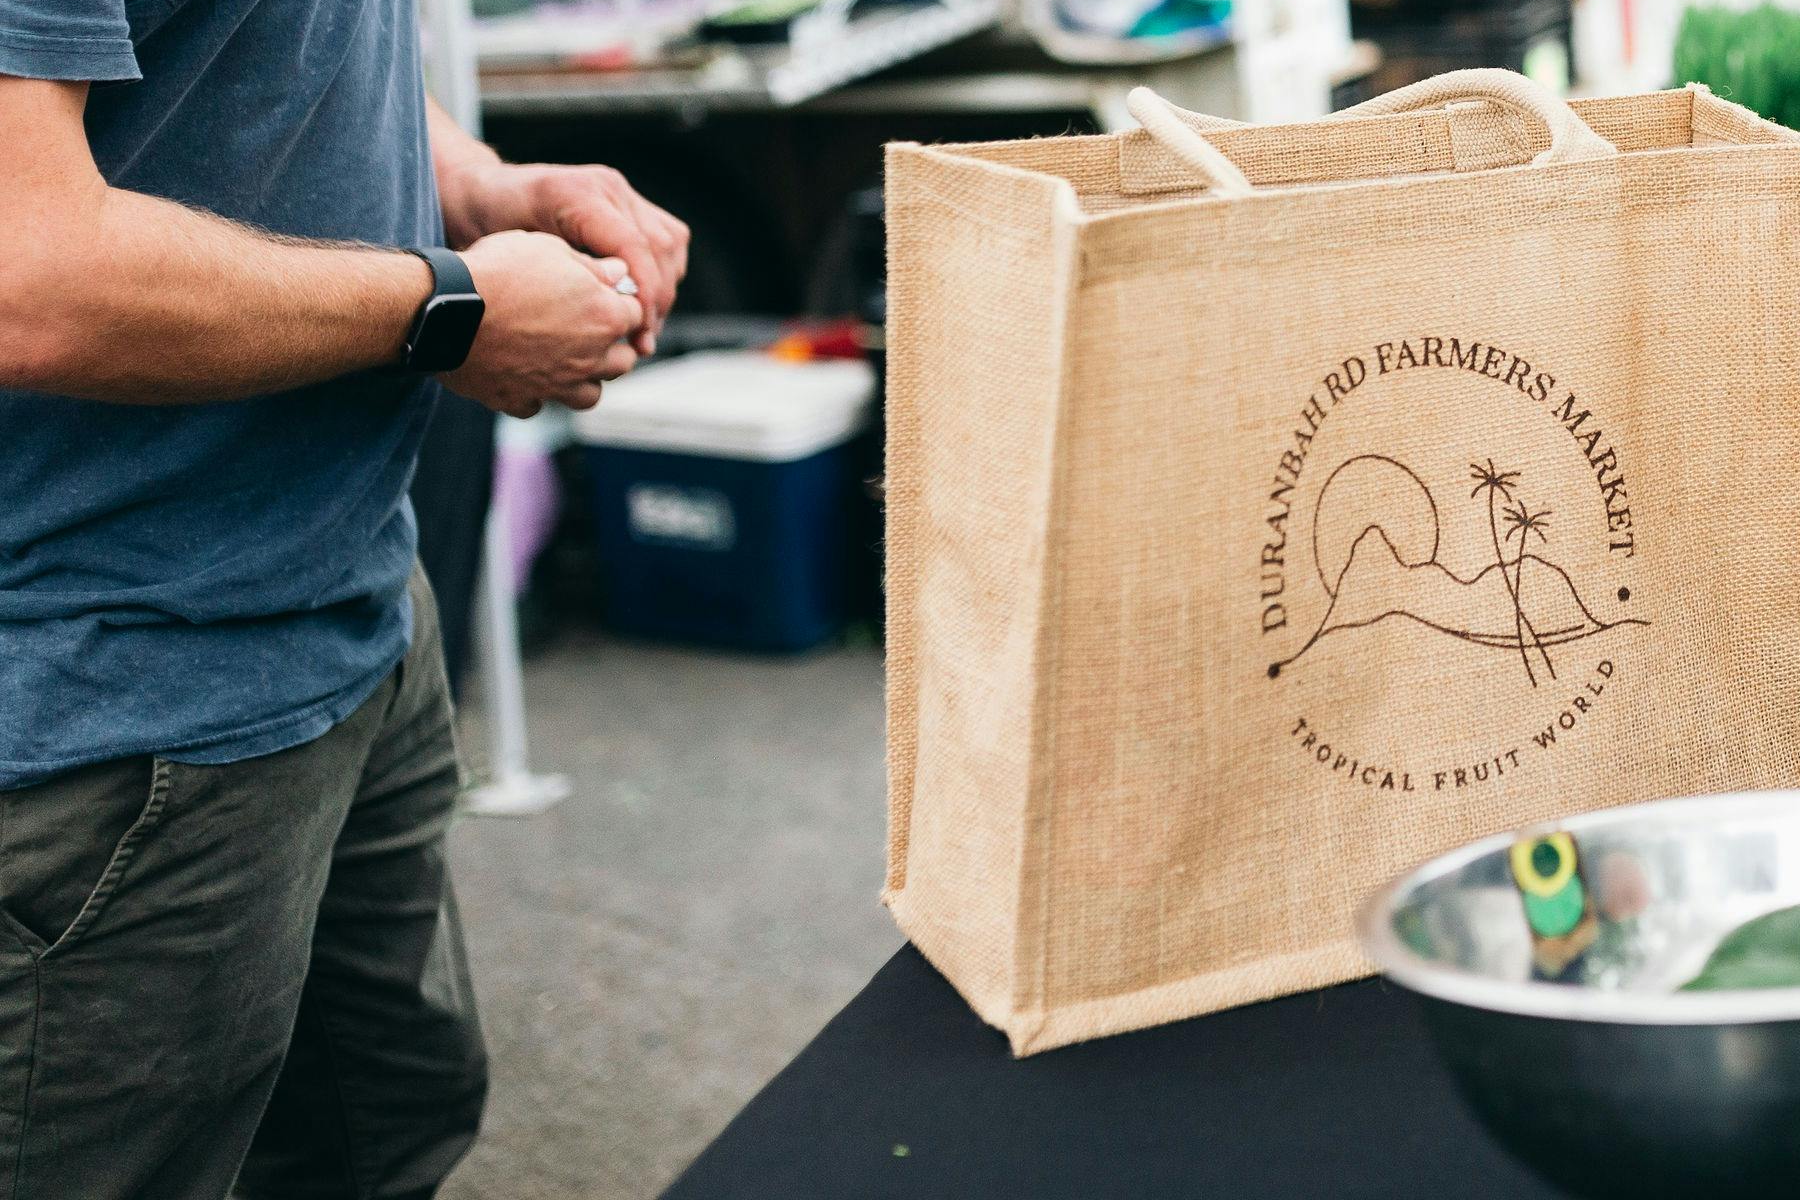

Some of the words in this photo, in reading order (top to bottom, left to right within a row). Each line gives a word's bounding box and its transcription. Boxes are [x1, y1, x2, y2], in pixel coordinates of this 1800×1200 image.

[1260, 394, 1327, 634] DURANBAH
[1323, 356, 1367, 406] RD
[1374, 336, 1557, 404] FARMERS
[1551, 392, 1636, 559] MARKET
[1291, 717, 1415, 792] TROPICAL
[1434, 749, 1523, 791] FRUIT
[1533, 659, 1615, 751] WORLD
